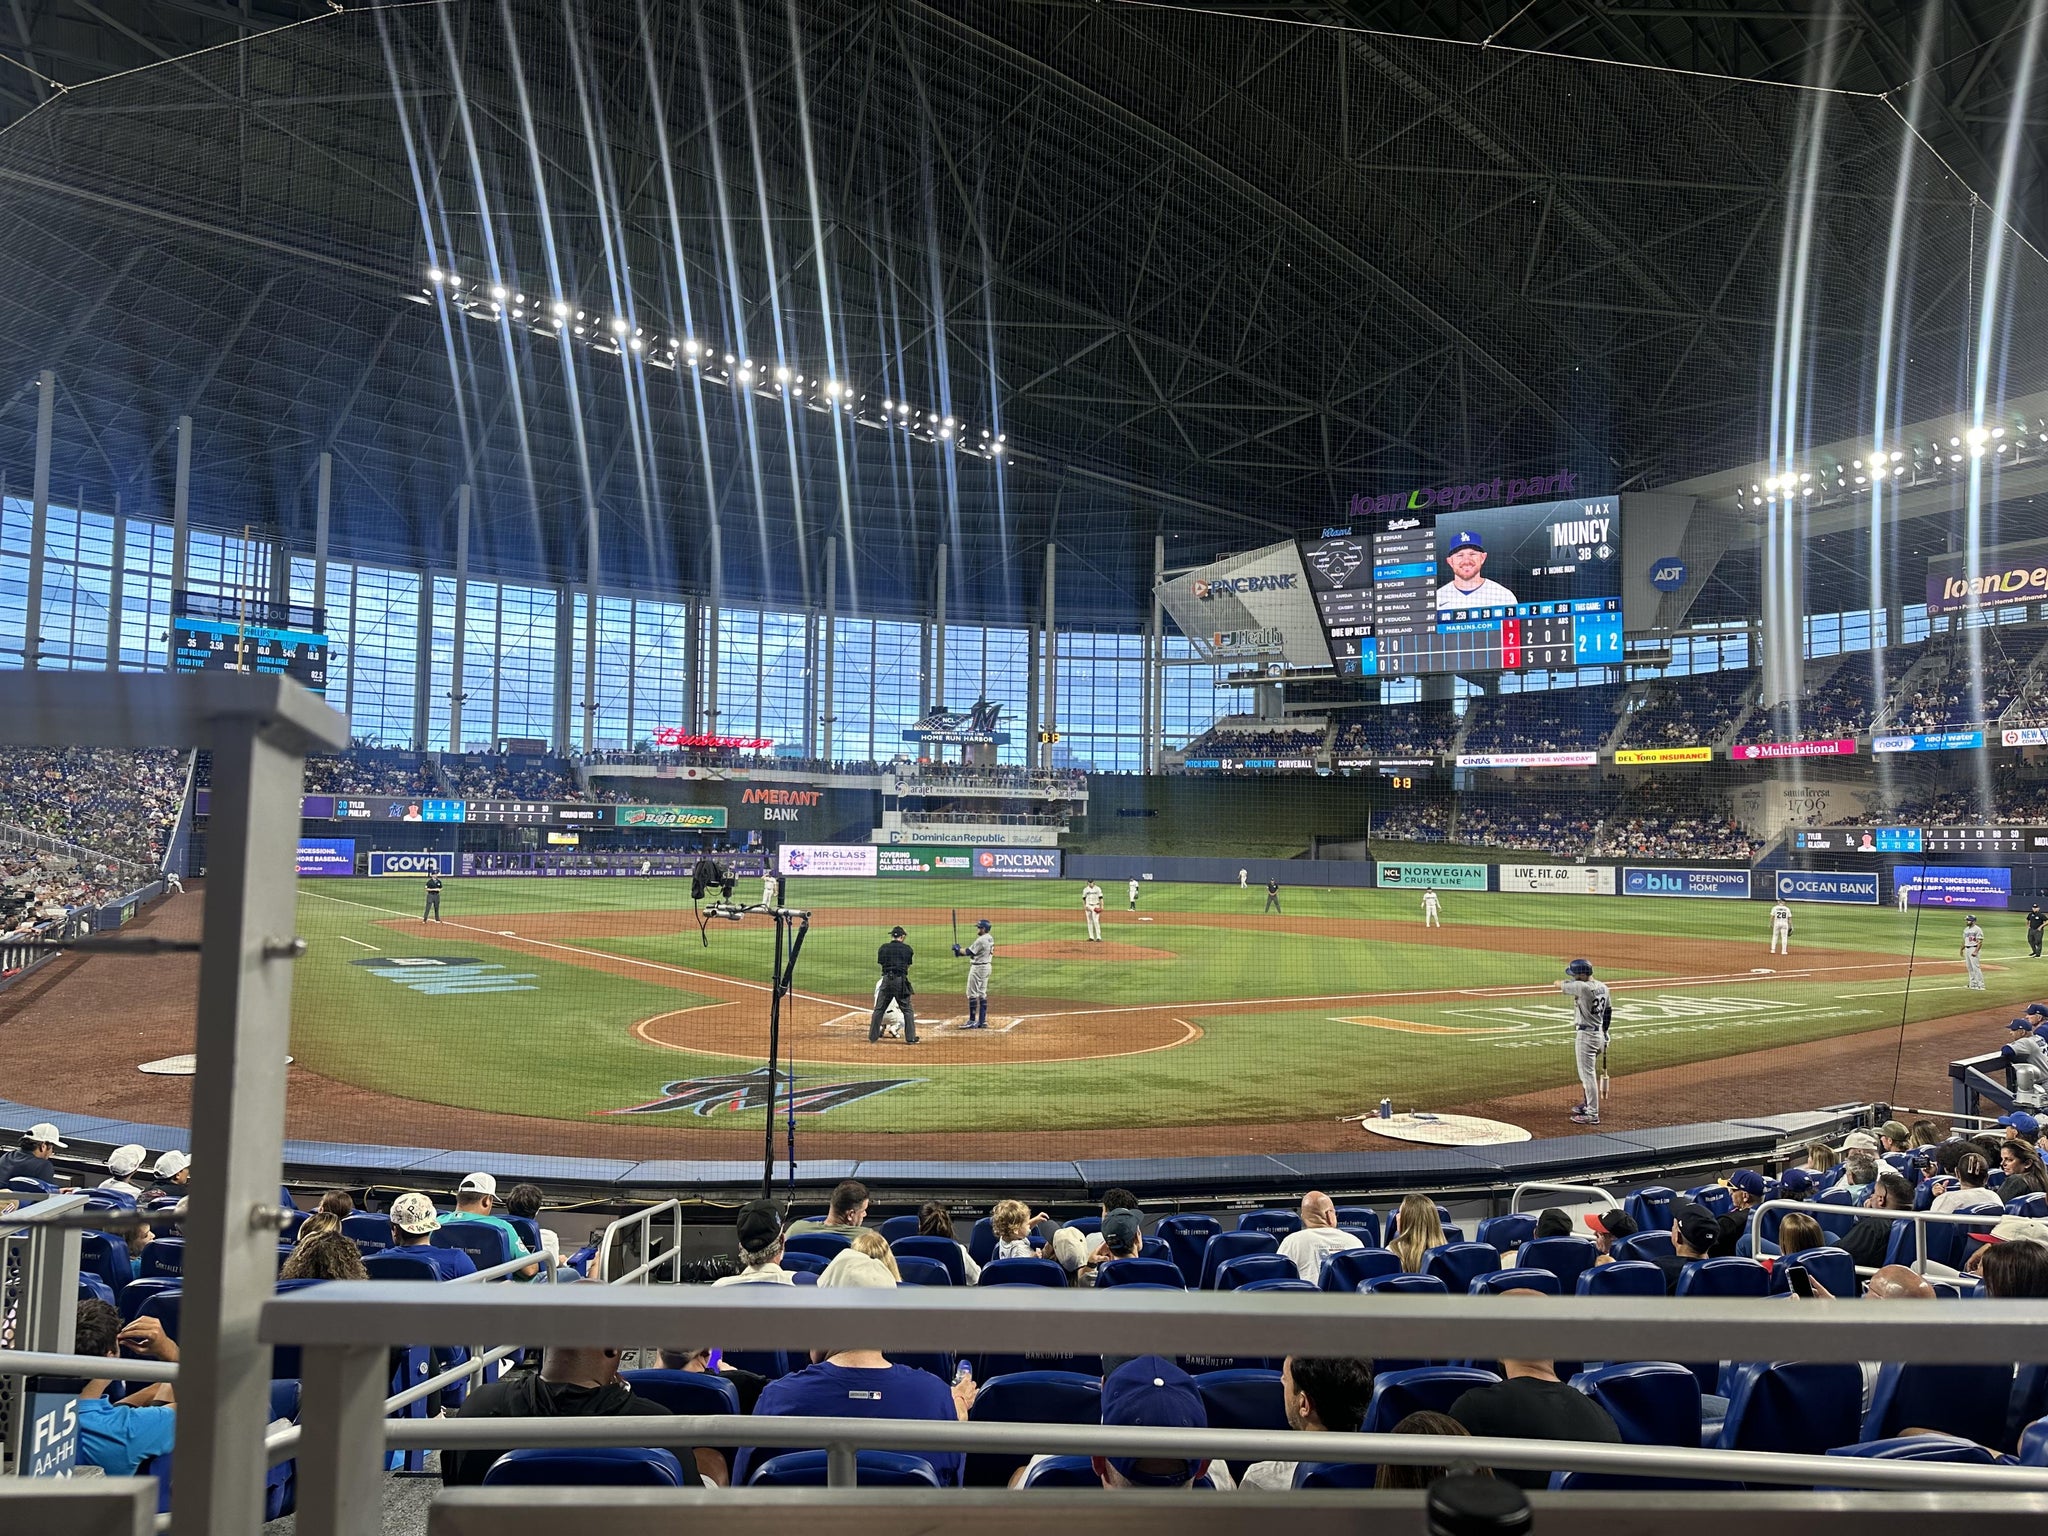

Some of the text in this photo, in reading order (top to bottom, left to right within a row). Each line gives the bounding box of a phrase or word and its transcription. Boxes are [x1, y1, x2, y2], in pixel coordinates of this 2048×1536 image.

[1351, 469, 1577, 516] loanDepot park
[1586, 504, 1609, 515] MAX
[1321, 527, 1352, 538] Miami
[1554, 519, 1609, 546] MUNCY
[1579, 547, 1609, 560] 3B 13
[1654, 567, 1683, 581] ADT
[1944, 567, 2048, 599] loanDe
[1575, 603, 1584, 611] THIS
[1355, 626, 1371, 635] NEXT
[1446, 623, 1493, 631] MARLINS.COM
[188, 639, 196, 647] 35
[1509, 633, 1514, 645] 2
[1528, 632, 1533, 644] 2
[1545, 631, 1550, 642] 0
[1580, 633, 1617, 652] 2 1 2
[1380, 641, 1398, 651] 2 0
[1369, 652, 1373, 661] 3
[1509, 650, 1566, 664] 3 5 0 2
[1380, 660, 1398, 670] 0 3
[2021, 731, 2037, 739] NEW
[1761, 743, 1839, 756] Multinational
[1660, 752, 1708, 761] INSURANCE
[1222, 760, 1232, 769] 82
[742, 789, 820, 806] AMERANT
[1789, 798, 1826, 814] 1796
[598, 811, 602, 819] 3
[646, 813, 676, 824] Baja
[677, 814, 714, 824] Blast
[764, 808, 799, 821] BANK
[1994, 842, 1999, 850] 2
[2012, 842, 2016, 850] 2
[387, 856, 437, 871] GOYA
[1405, 868, 1481, 877] NORWEGIAN
[1515, 869, 1569, 879] LIVE. FIT. GO.
[1647, 874, 1682, 890] blu
[1689, 875, 1744, 883] DEFENDING
[1689, 883, 1718, 891] HOME
[1796, 882, 1874, 894] OCEAN BANK
[34, 1399, 77, 1454] FL5
[34, 1438, 75, 1478] AA-HH
